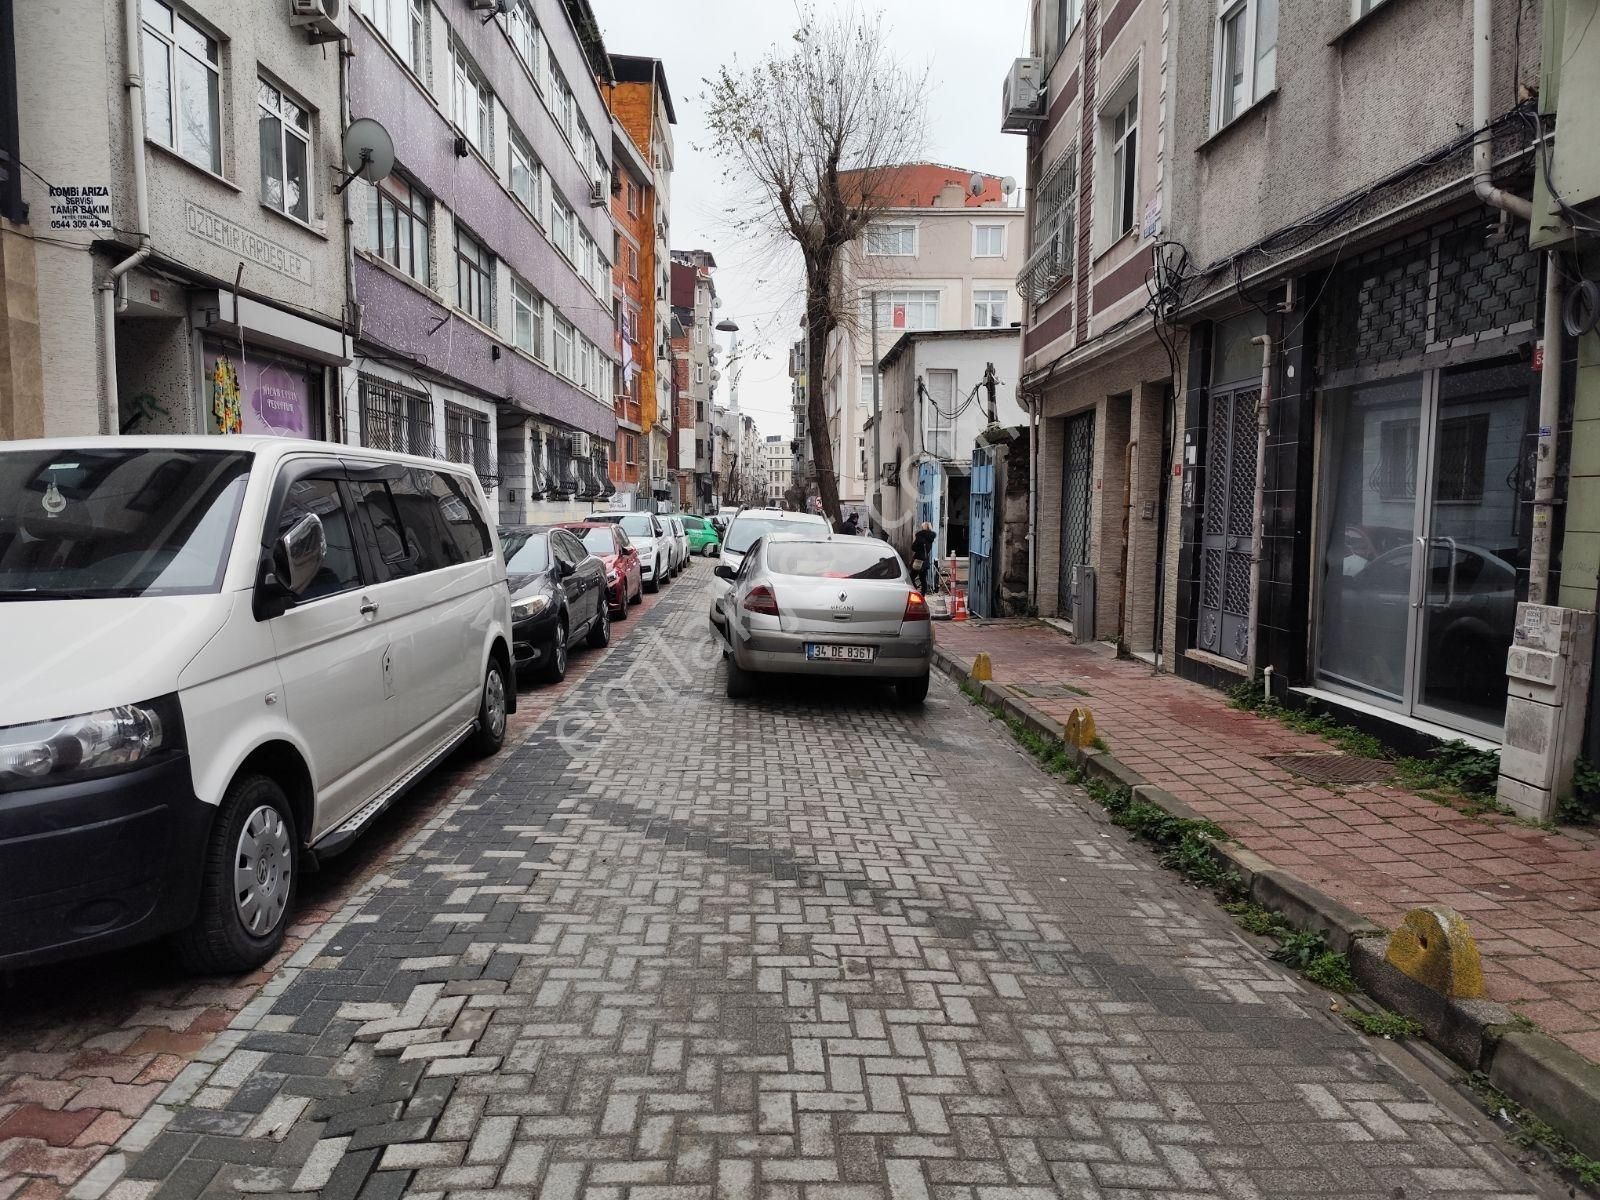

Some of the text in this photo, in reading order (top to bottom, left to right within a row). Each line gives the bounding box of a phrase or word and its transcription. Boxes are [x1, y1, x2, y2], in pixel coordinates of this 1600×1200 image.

[82, 187, 108, 196] ARIZA
[51, 220, 70, 228] 0544
[73, 220, 87, 228] 309
[814, 645, 871, 658] 34 DE 8361
